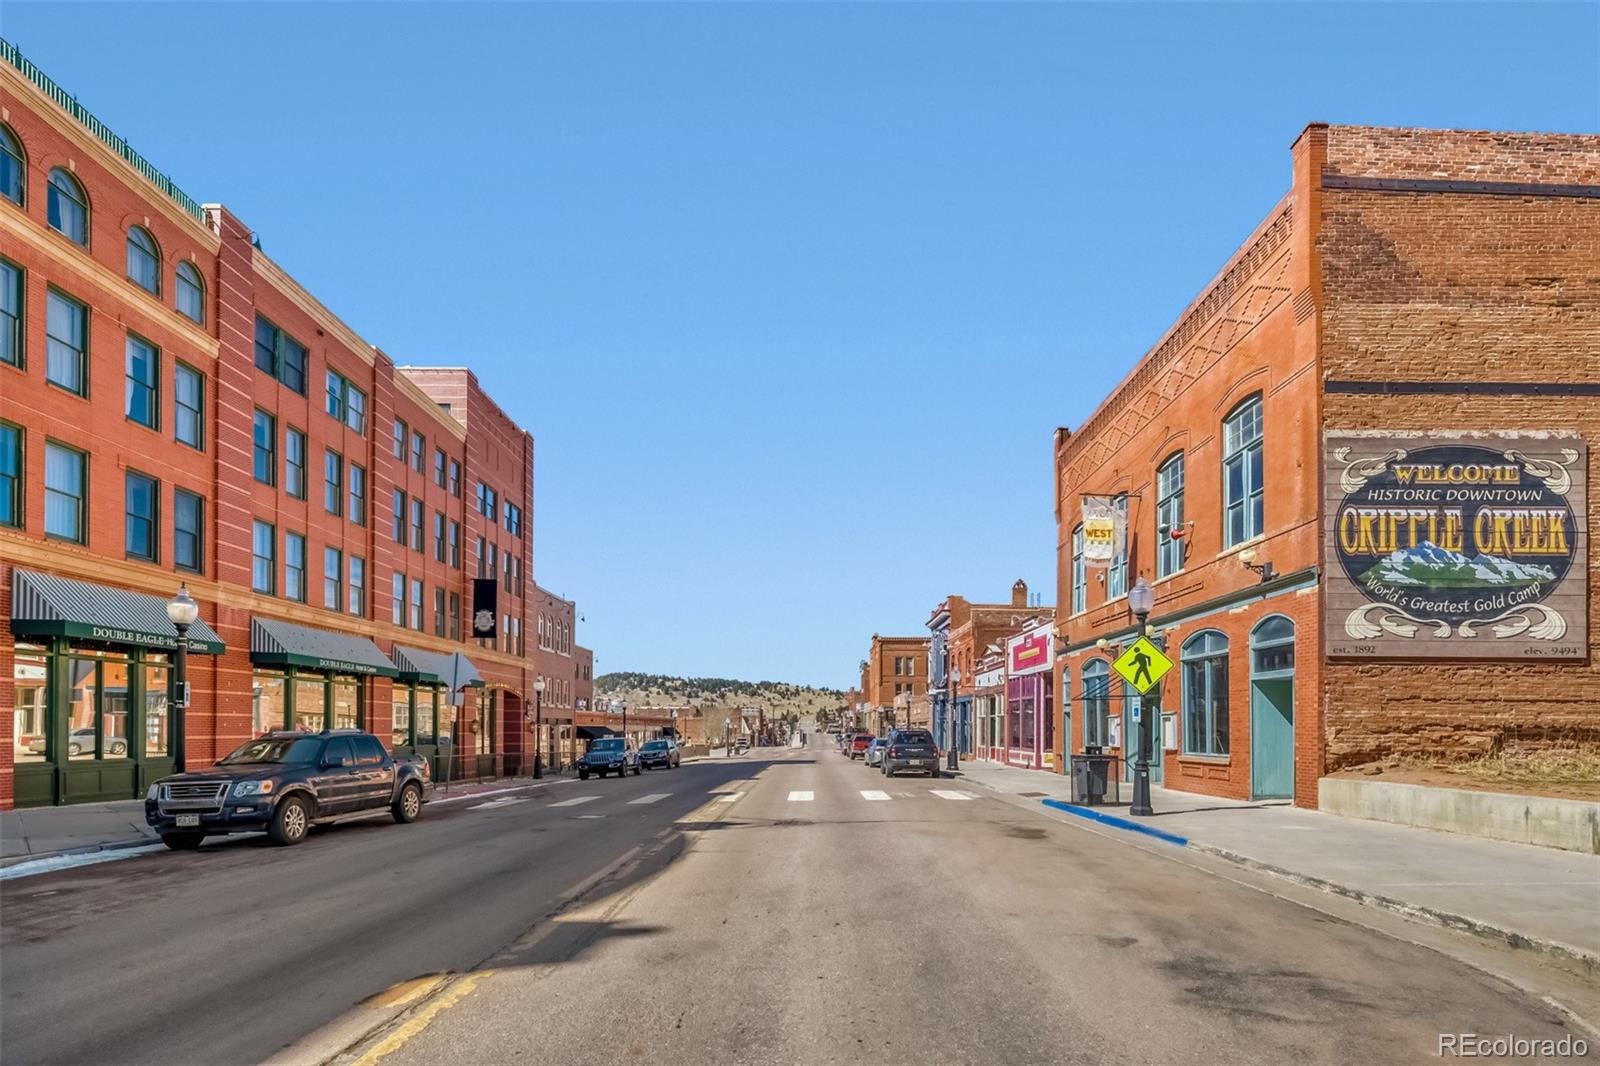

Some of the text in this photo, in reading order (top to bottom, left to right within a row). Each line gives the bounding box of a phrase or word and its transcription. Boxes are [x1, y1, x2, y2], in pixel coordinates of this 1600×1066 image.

[1391, 464, 1520, 484] WELCOME
[1368, 489, 1542, 501] HISTORIC DOWNTOWN
[1086, 528, 1112, 538] WEST
[1339, 505, 1569, 558] CRIPPLE CREEK
[1410, 597, 1470, 613] Greatest
[1474, 593, 1505, 612] Gold
[93, 627, 133, 641] DOUBLE
[136, 633, 164, 646] EAGLE
[1355, 645, 1376, 654] 1892
